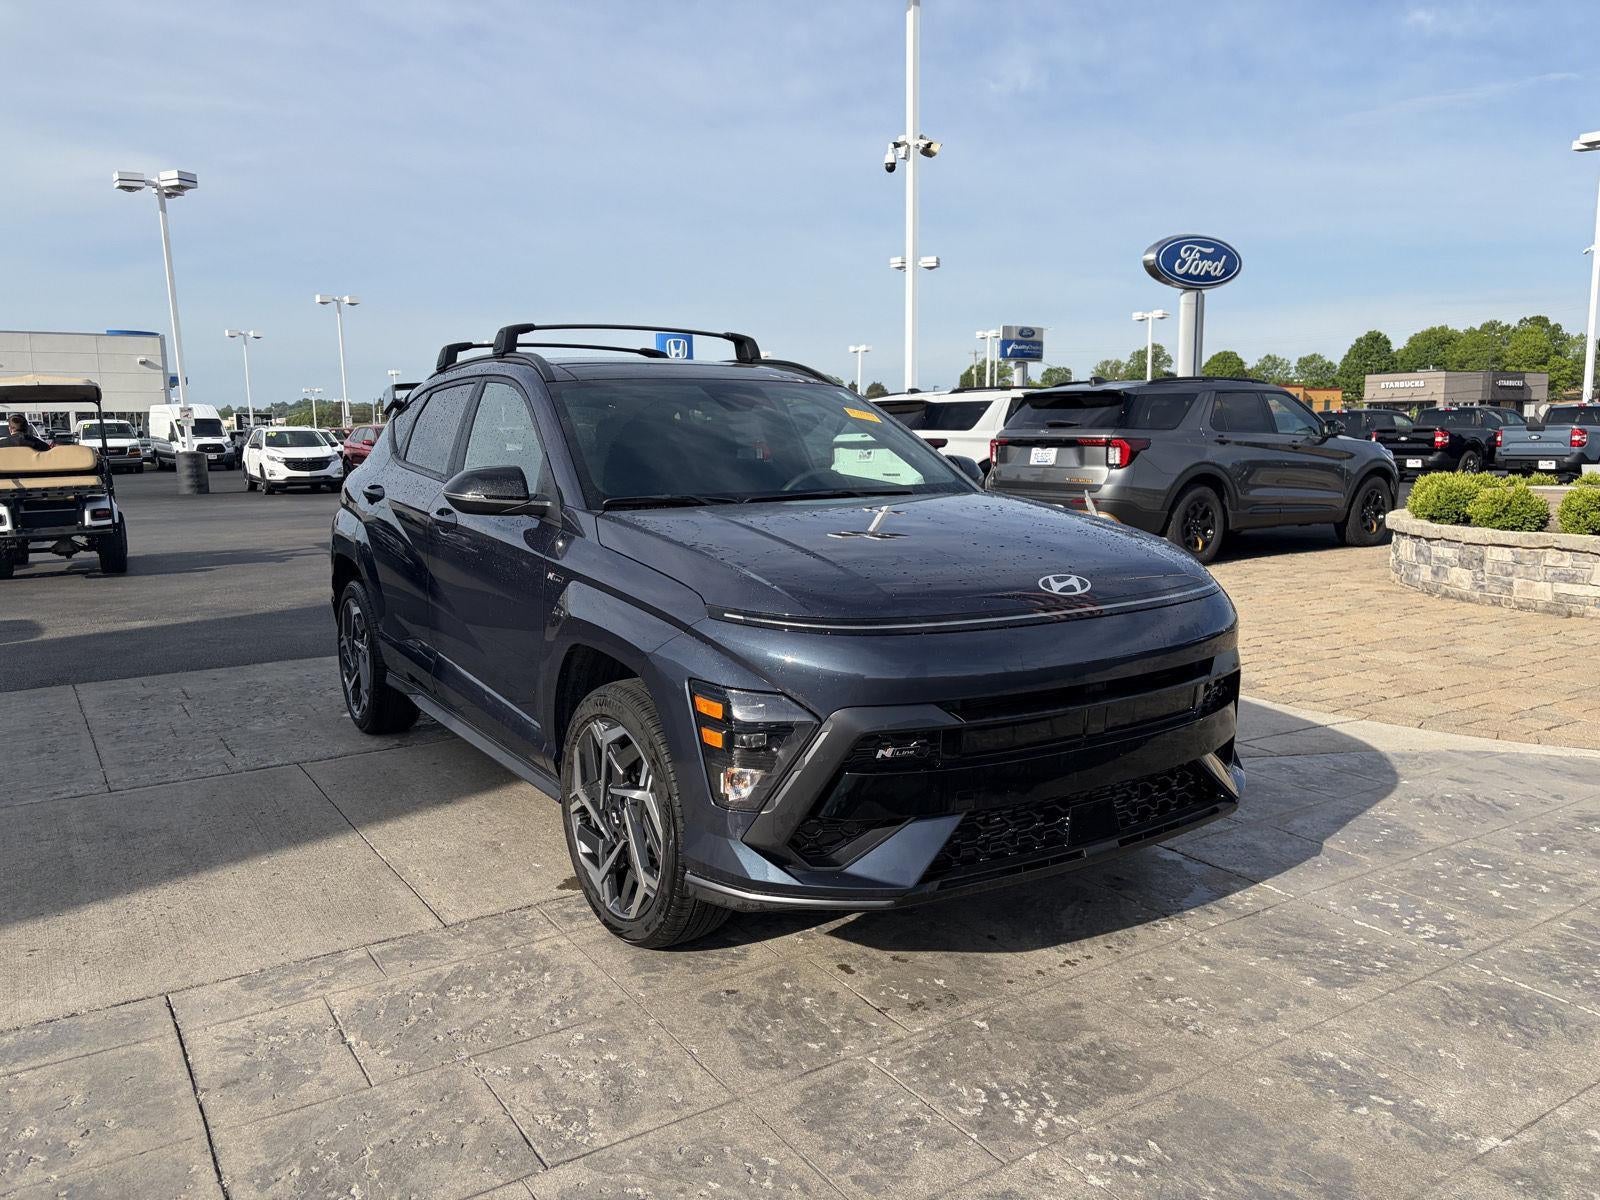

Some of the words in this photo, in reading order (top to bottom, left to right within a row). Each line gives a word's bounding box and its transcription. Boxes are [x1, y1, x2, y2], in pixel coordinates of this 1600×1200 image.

[1174, 244, 1226, 277] Ford
[1380, 380, 1425, 389] STARBUCKS
[1498, 379, 1523, 387] STARBUCKS
[876, 747, 894, 759] N
